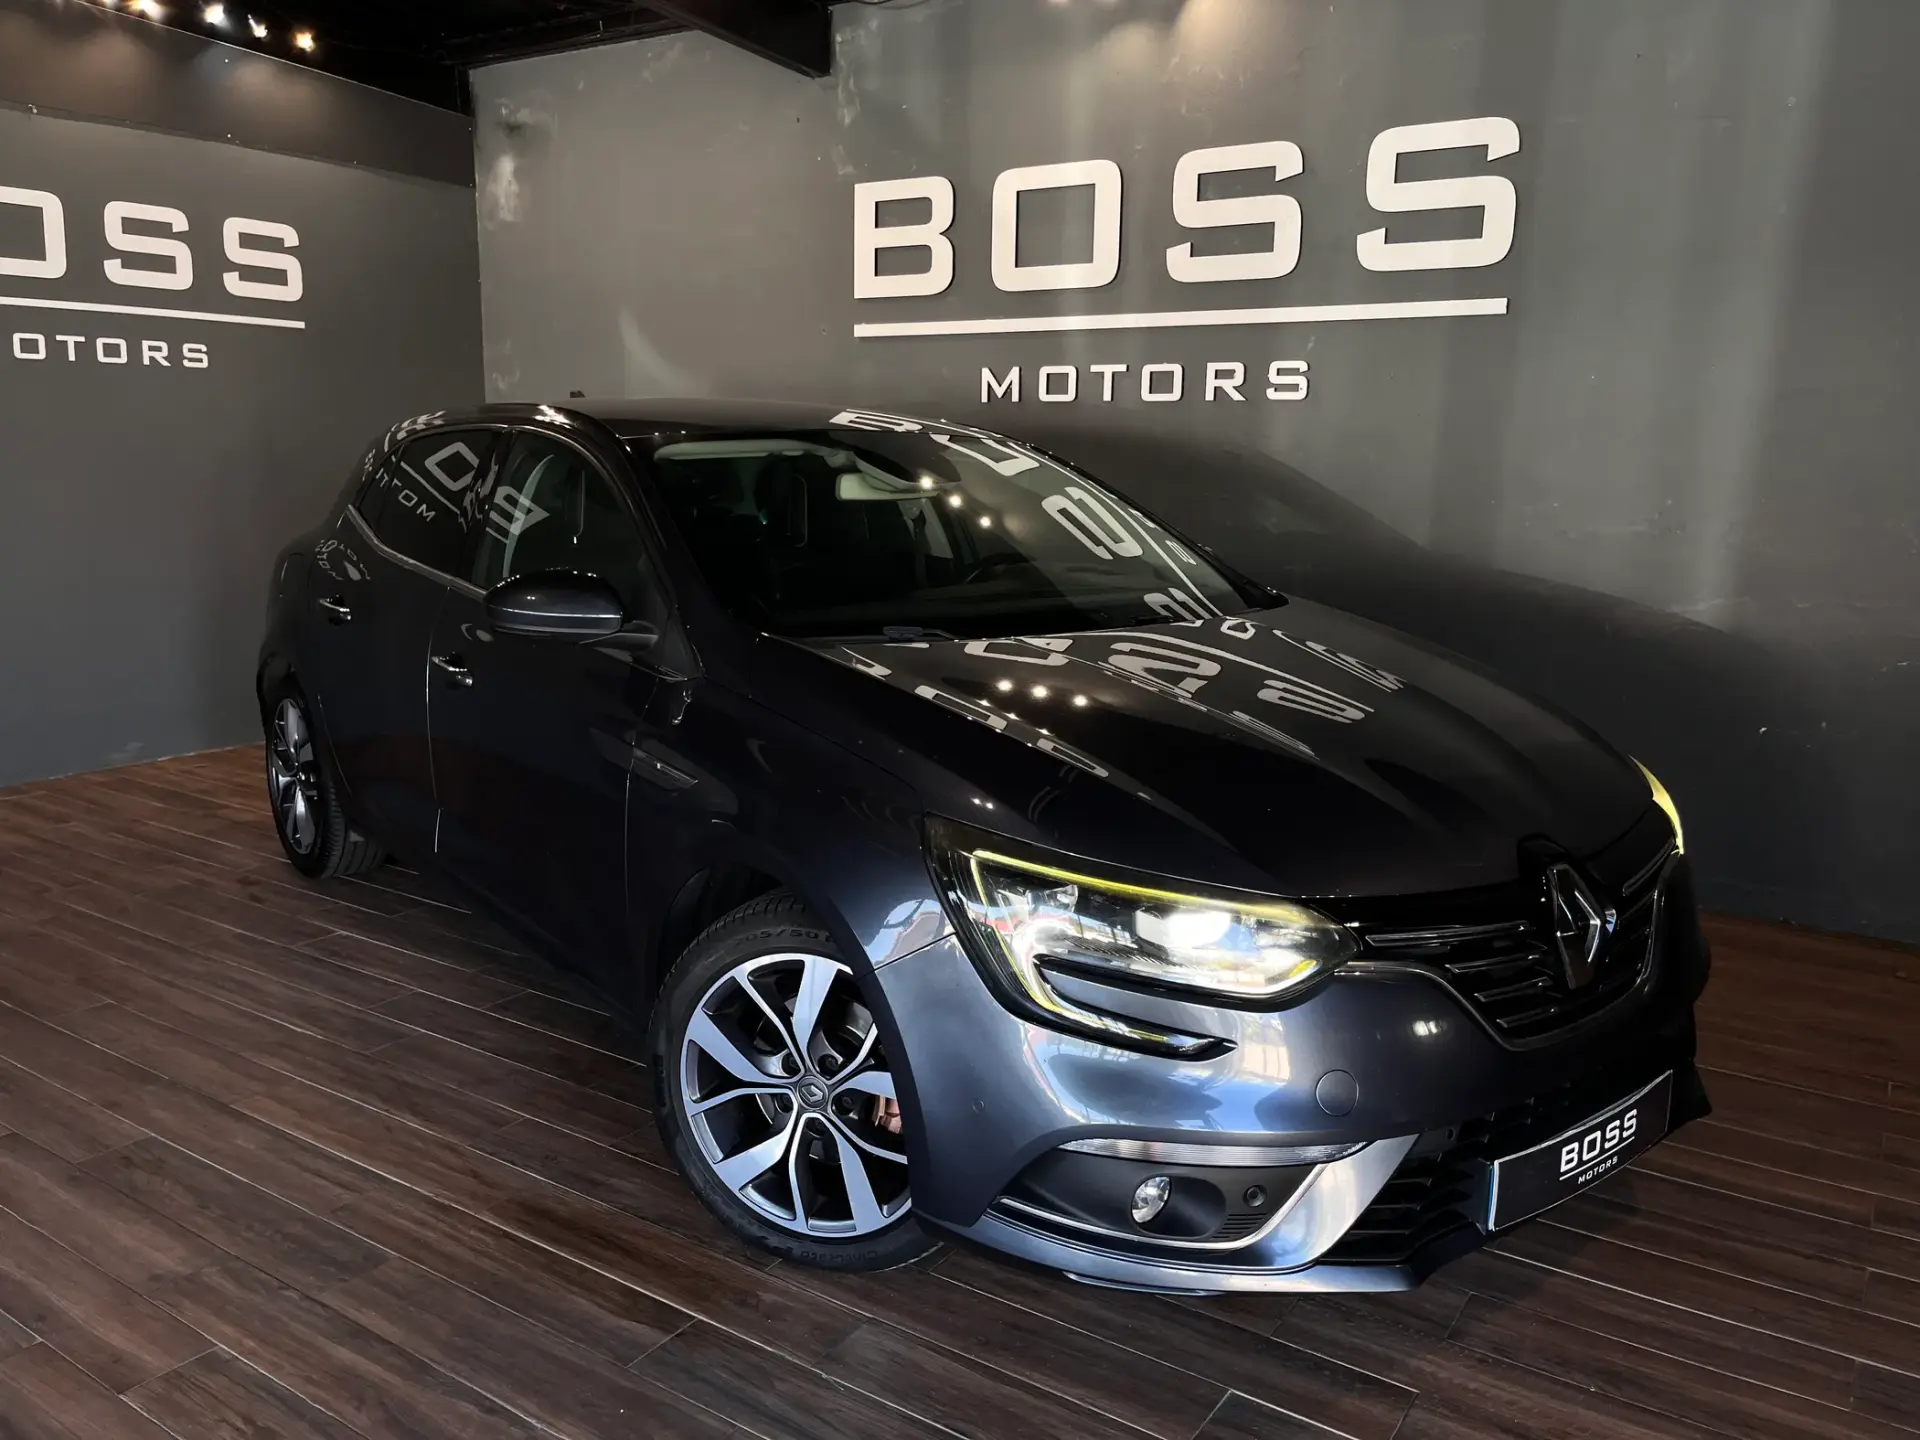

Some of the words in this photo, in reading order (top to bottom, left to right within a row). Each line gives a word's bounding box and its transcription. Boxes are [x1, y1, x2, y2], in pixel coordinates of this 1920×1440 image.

[854, 117, 1521, 300] BOSS
[0, 186, 303, 302] OSS
[12, 332, 209, 369] OTORS
[980, 360, 1310, 404] MOTORS
[1560, 1108, 1637, 1173] BOSS
[1577, 1155, 1619, 1185] MOTORS
